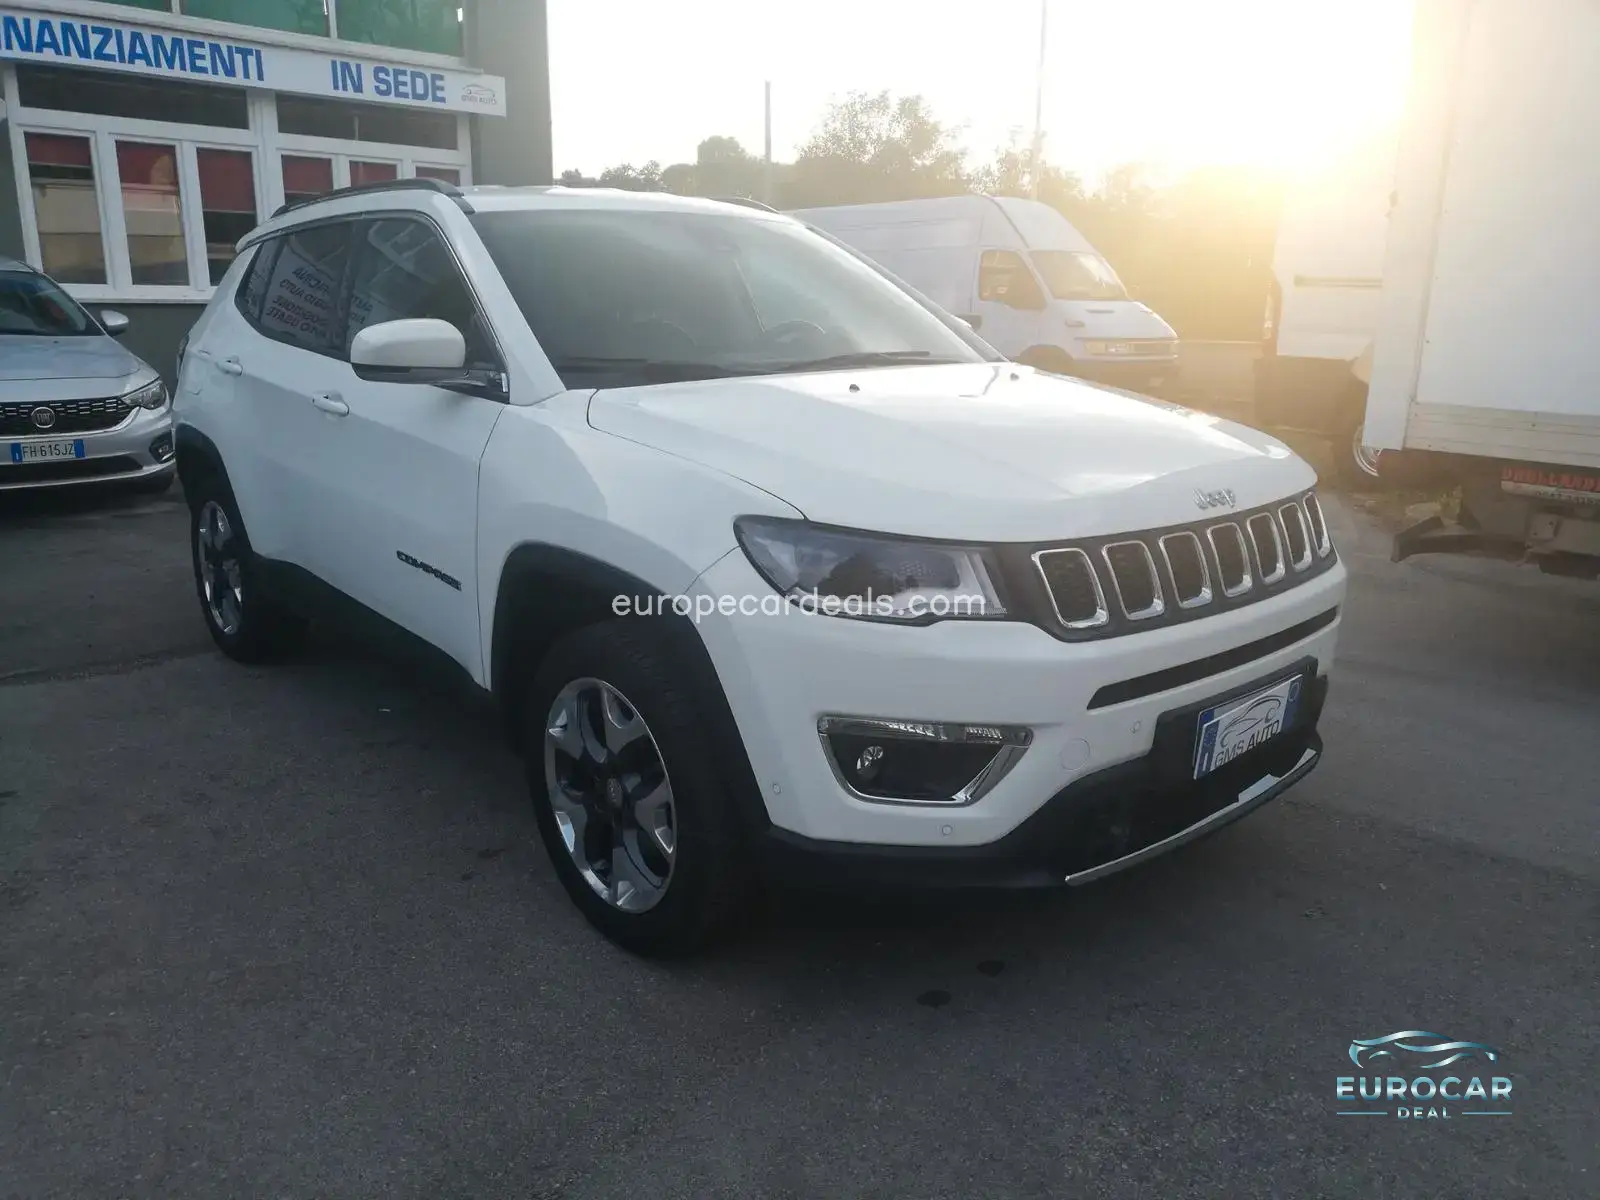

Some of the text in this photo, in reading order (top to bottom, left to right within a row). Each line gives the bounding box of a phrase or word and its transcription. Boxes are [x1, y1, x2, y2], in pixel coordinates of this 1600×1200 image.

[0, 15, 447, 104] NANZIAMENTI IN SEDE
[22, 443, 75, 459] FH 615JZ
[1193, 488, 1236, 511] Jeep
[1215, 719, 1281, 766] GMS AUTO
